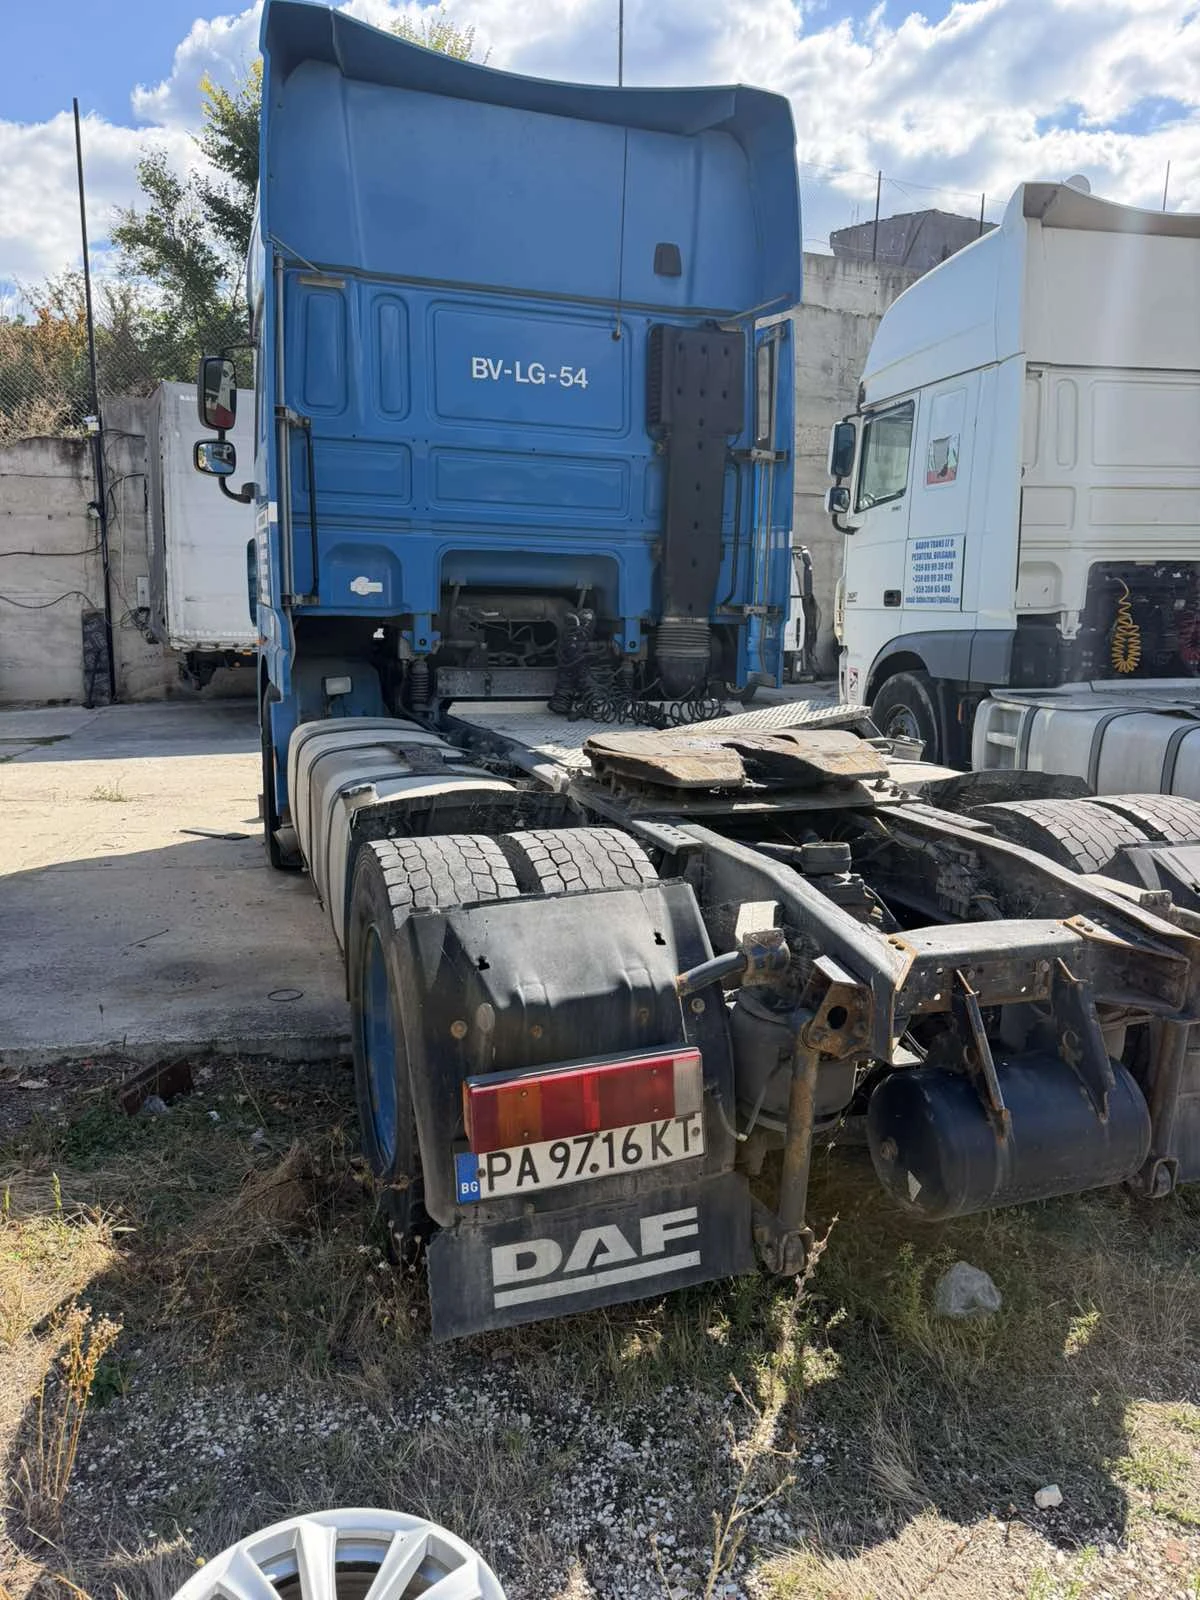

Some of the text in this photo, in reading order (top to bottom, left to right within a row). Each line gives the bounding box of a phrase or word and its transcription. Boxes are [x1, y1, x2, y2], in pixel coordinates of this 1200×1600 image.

[472, 356, 588, 389] BV-LG-54
[461, 1181, 478, 1194] BG
[491, 1206, 699, 1287] DAF
